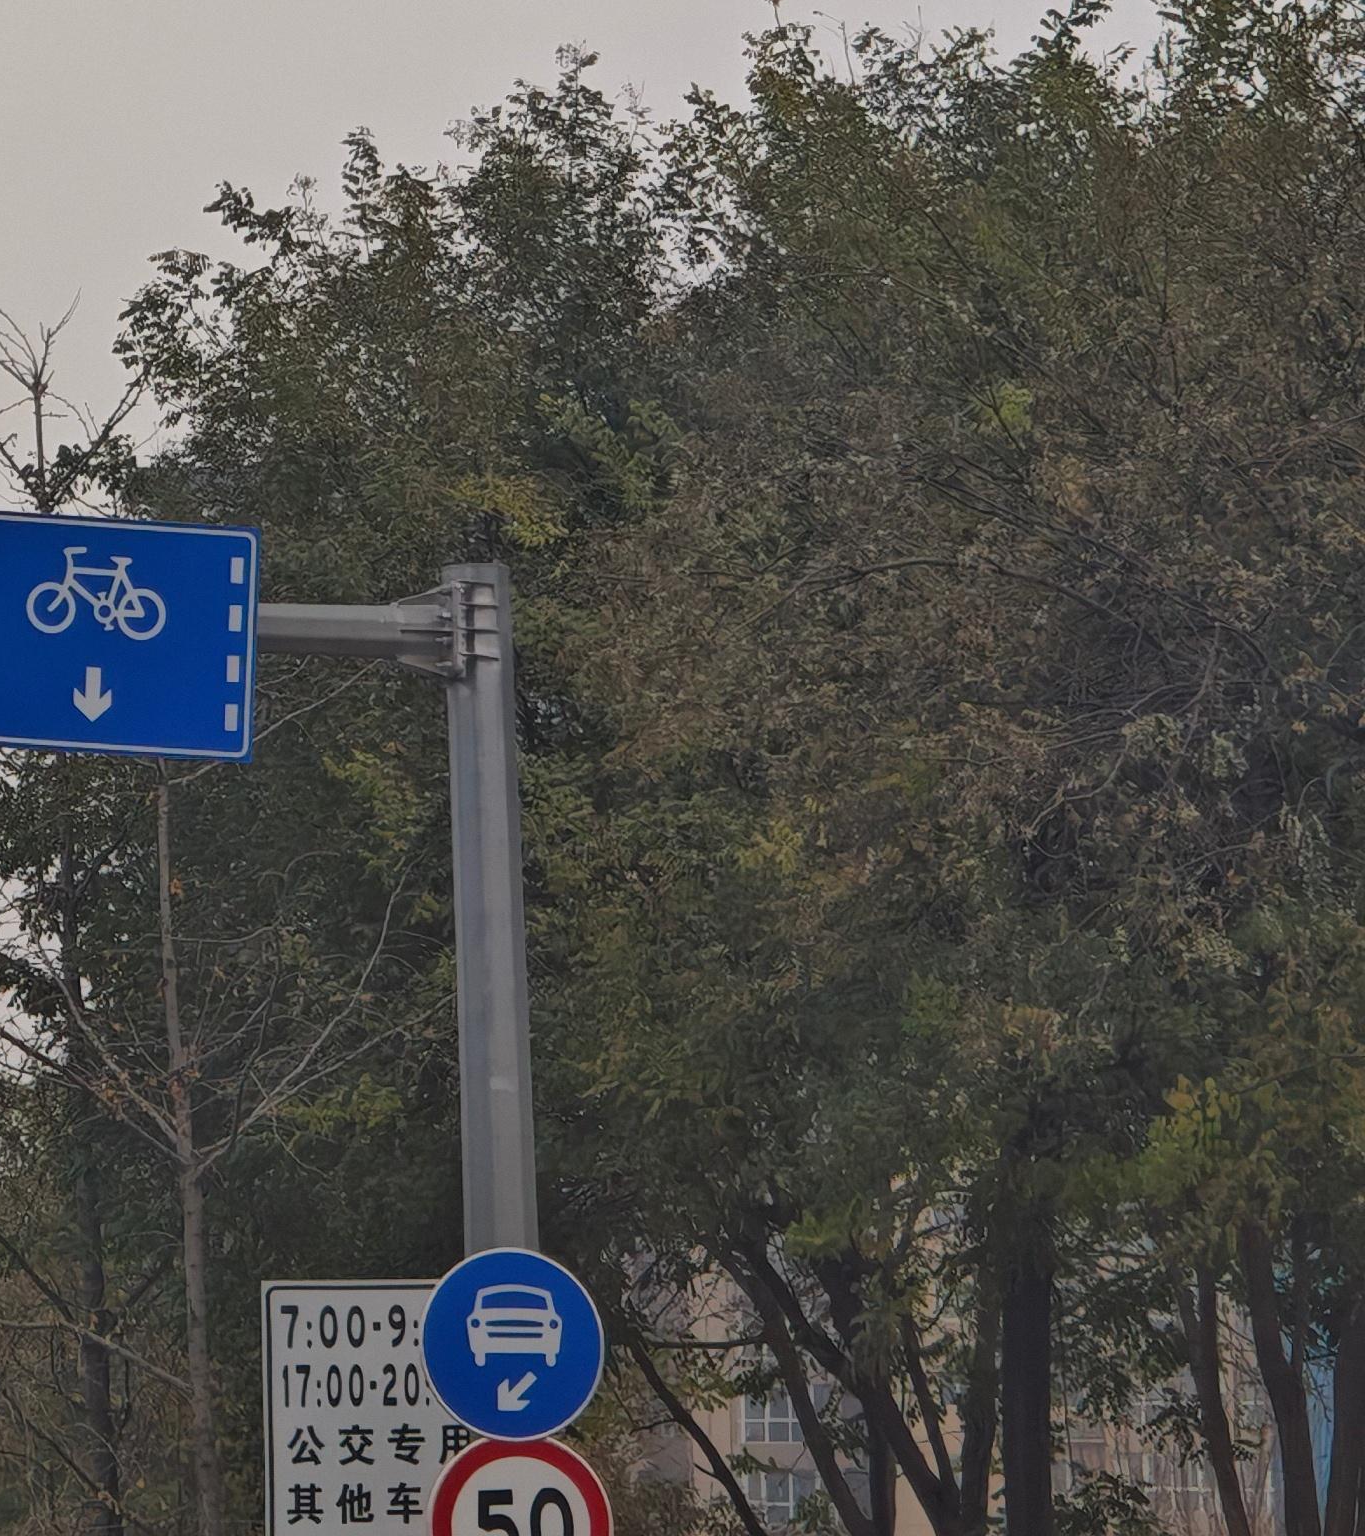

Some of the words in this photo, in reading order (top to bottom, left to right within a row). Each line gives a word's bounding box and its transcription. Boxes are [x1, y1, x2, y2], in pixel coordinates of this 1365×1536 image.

[286, 1482, 424, 1526] 其他车
[477, 1487, 575, 1536] 50
